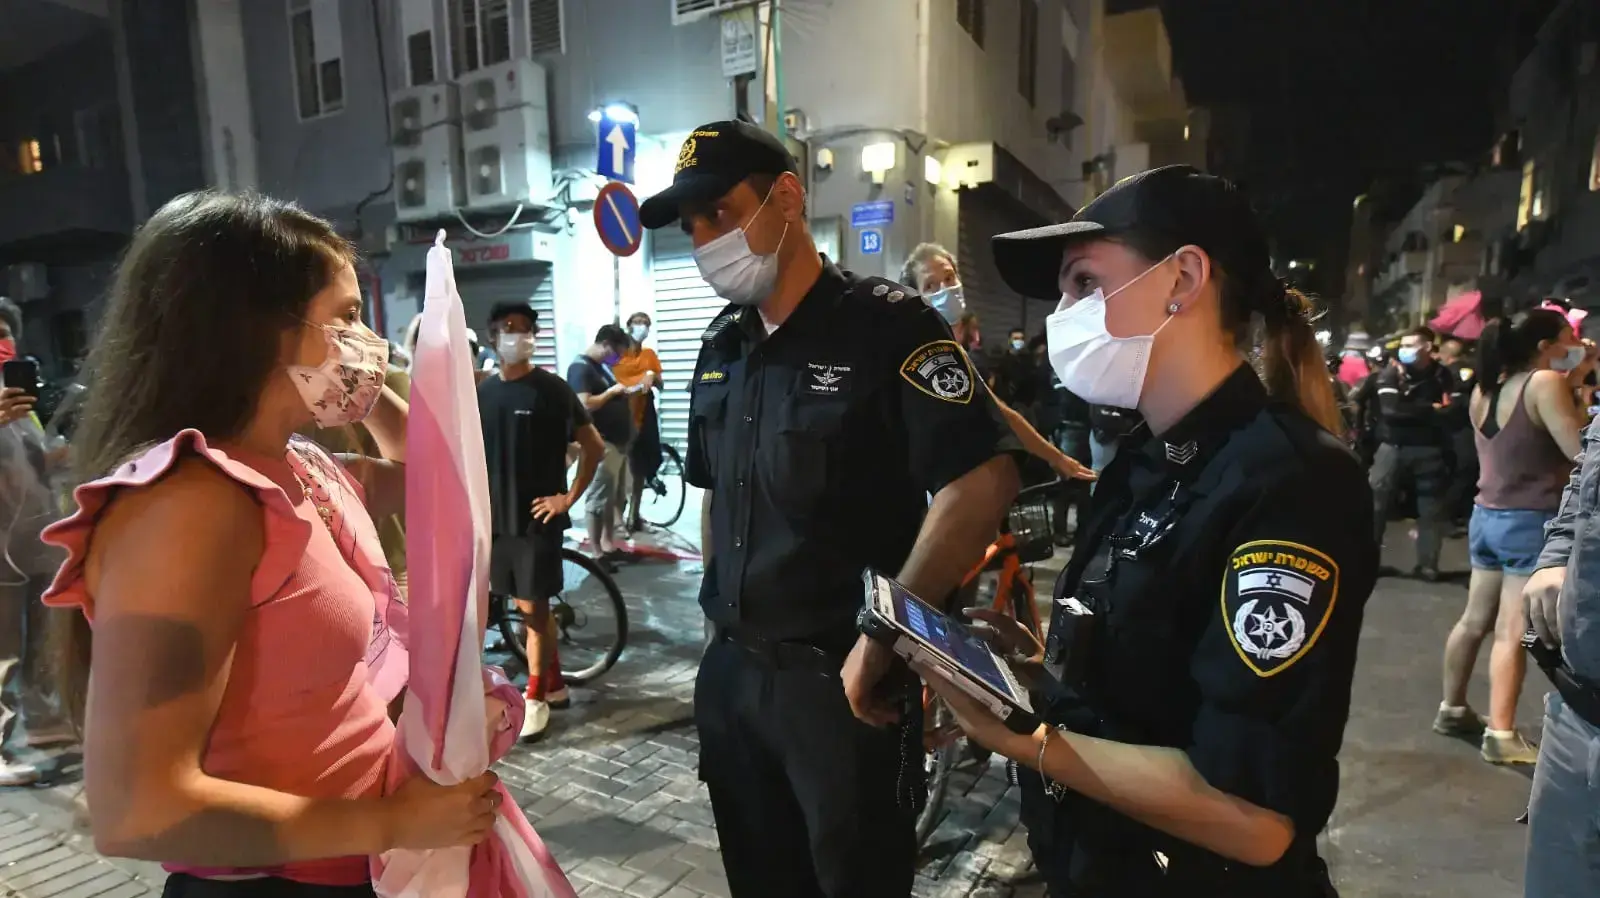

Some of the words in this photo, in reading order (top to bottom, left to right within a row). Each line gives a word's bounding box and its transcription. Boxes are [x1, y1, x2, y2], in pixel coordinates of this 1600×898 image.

[863, 233, 878, 250] 13
[1233, 551, 1274, 570] ישראל
[1273, 552, 1331, 581] משטרת
